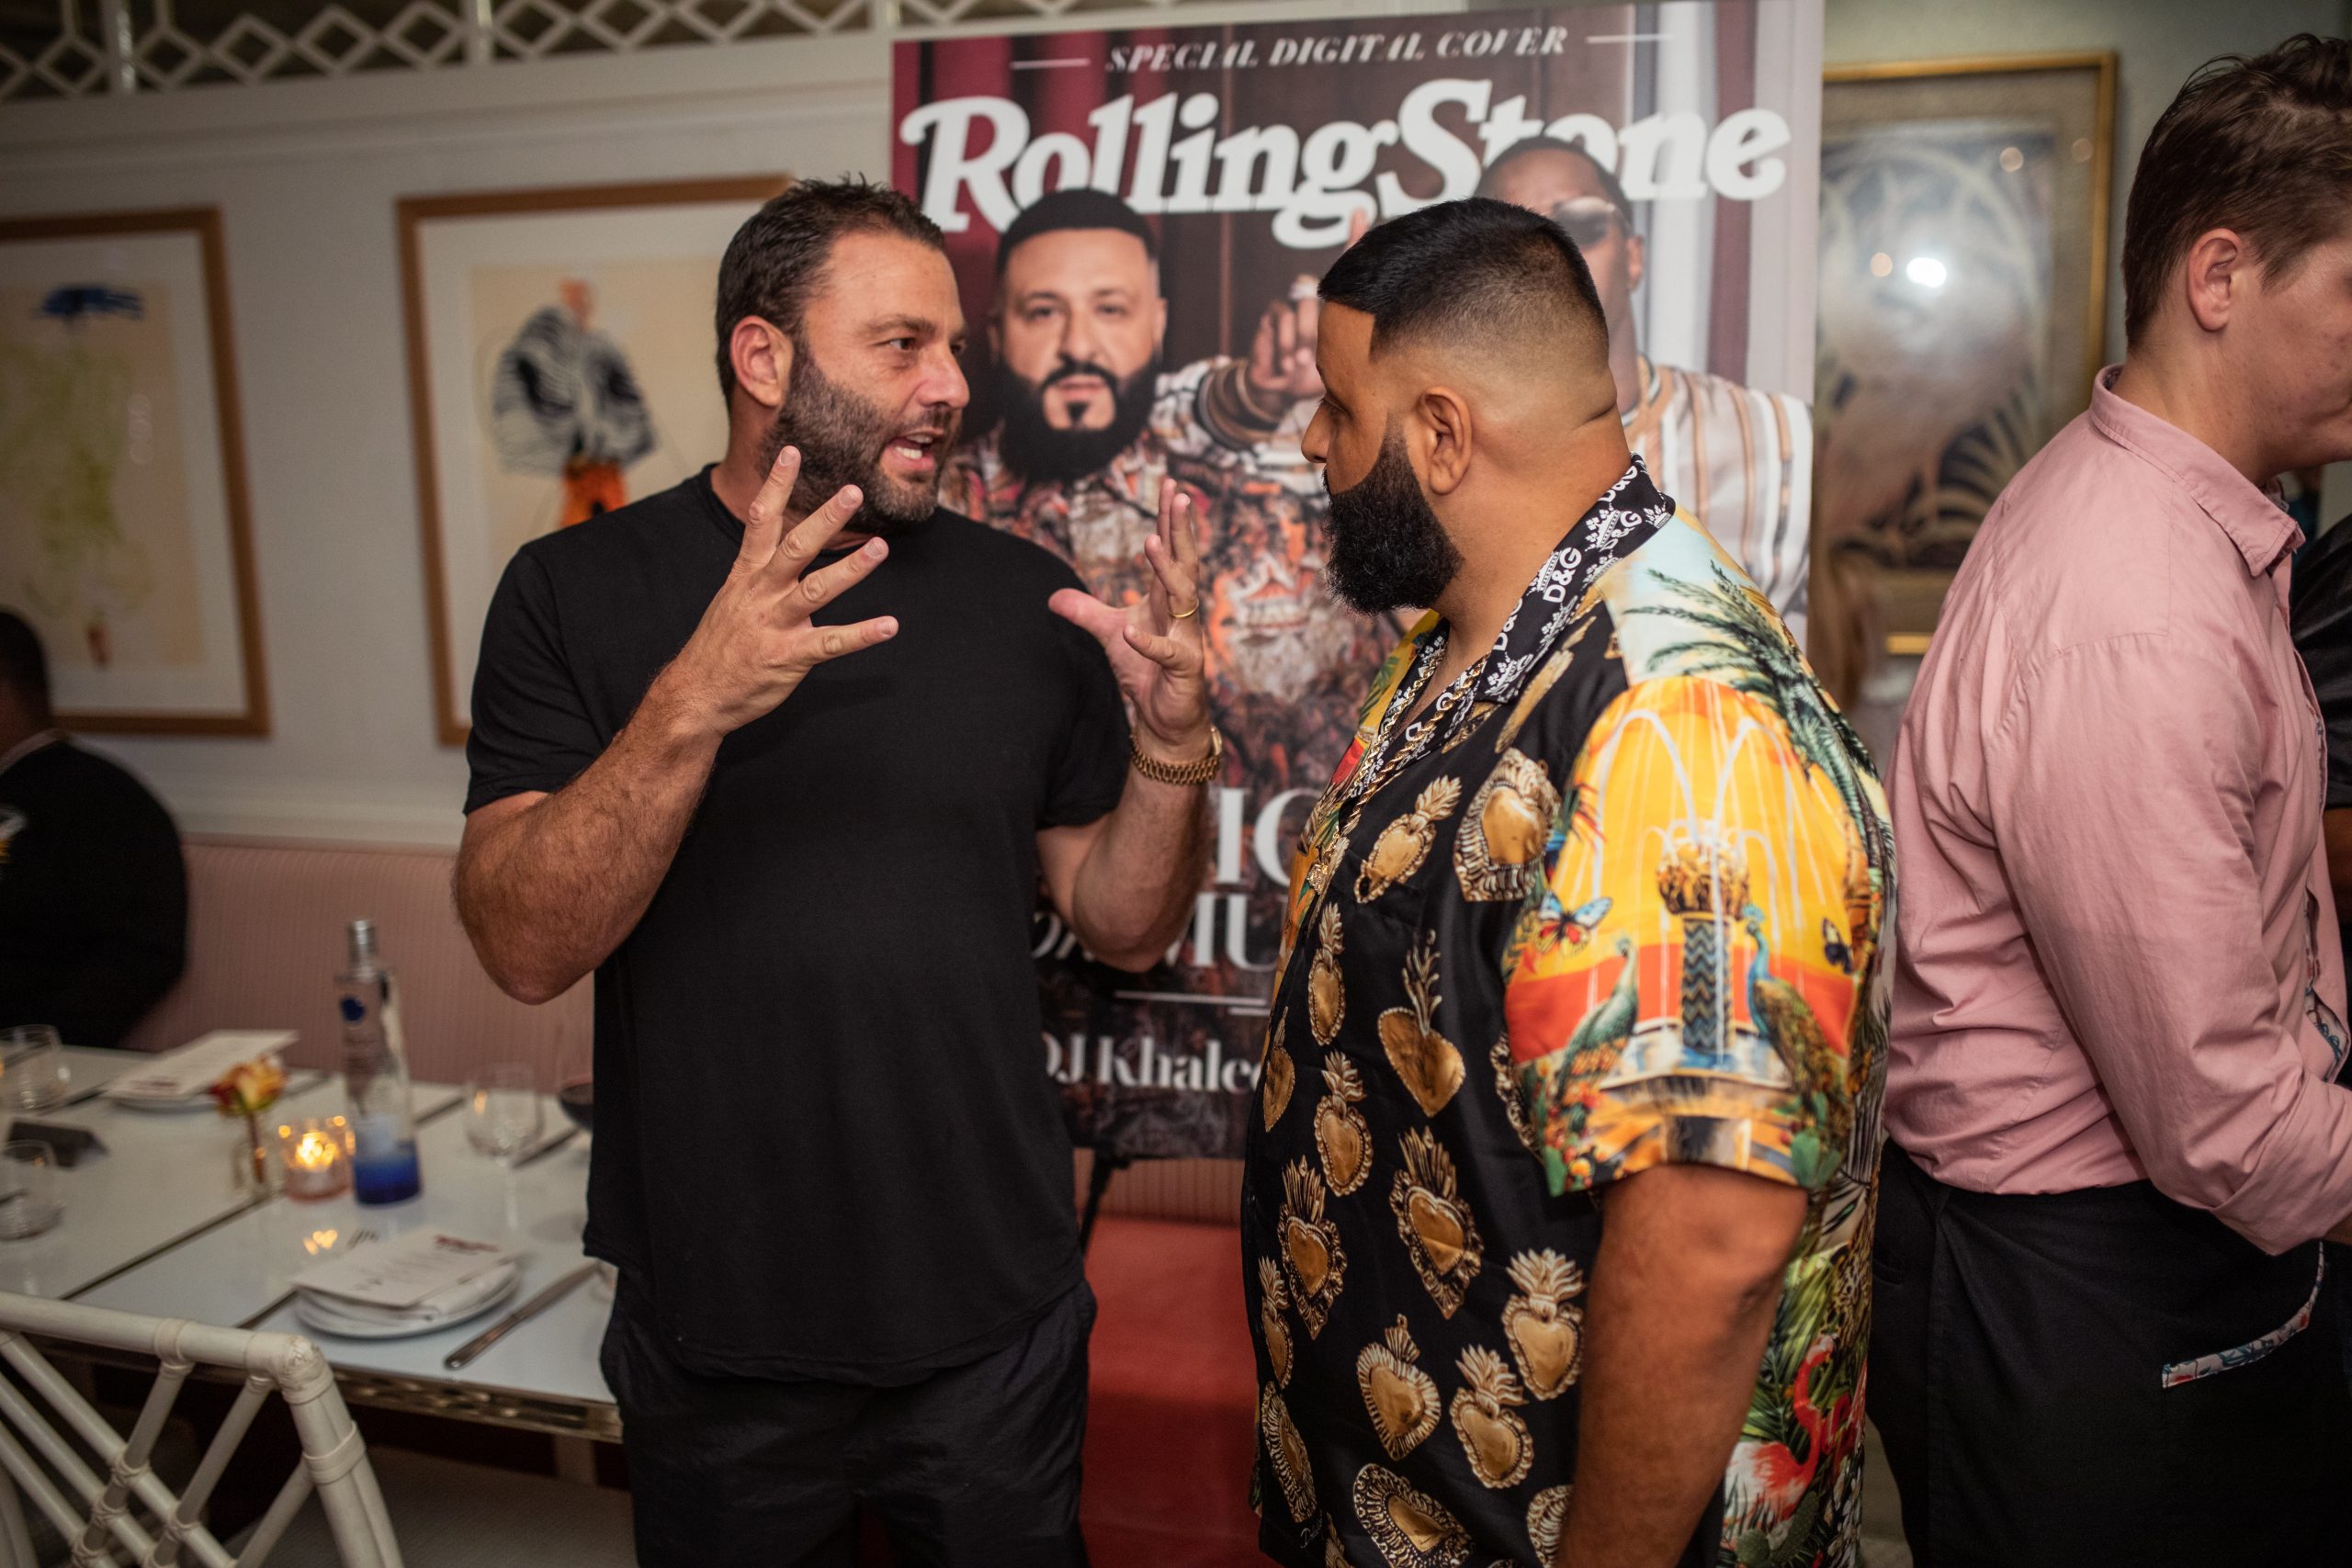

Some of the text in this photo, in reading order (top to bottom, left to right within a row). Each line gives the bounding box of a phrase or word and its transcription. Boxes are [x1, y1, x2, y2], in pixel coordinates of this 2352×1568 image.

[1105, 26, 1567, 73] SPECIAL DIGITAL COVER
[1599, 510, 1643, 552] D&G
[1543, 547, 1582, 604] D&G
